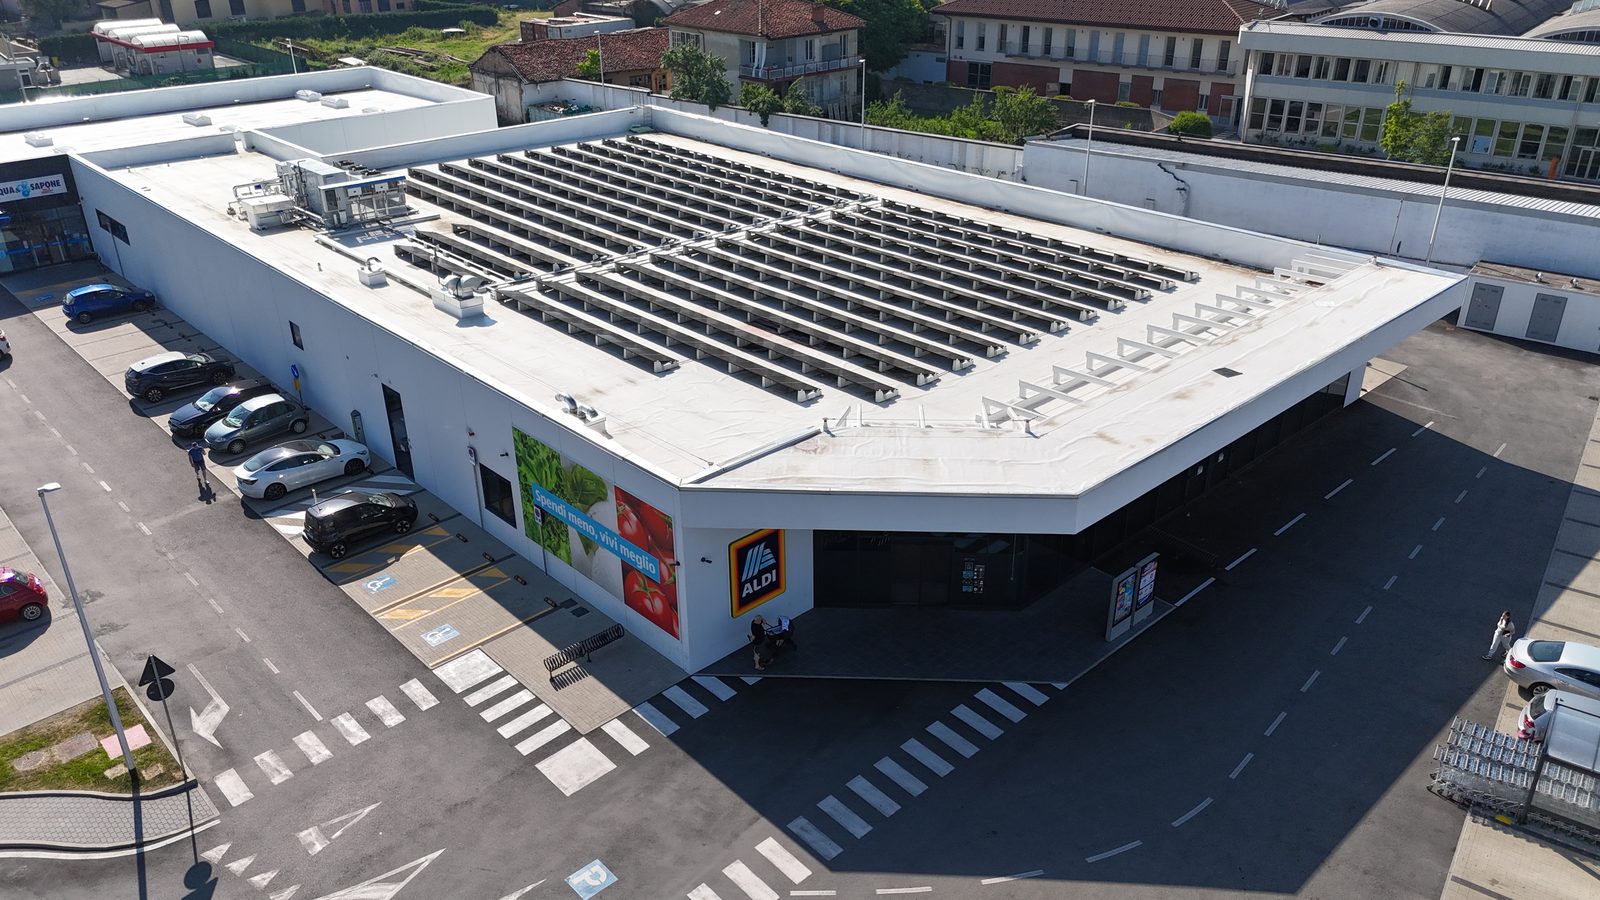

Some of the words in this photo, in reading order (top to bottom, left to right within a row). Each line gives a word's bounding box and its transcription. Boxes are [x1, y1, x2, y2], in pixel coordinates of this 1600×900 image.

[30, 180, 61, 190] SAPONE
[535, 490, 566, 518] Spendi
[568, 511, 598, 540] meno,
[600, 531, 618, 551] vivi
[620, 544, 656, 574] meglio
[742, 569, 776, 597] ALDI
